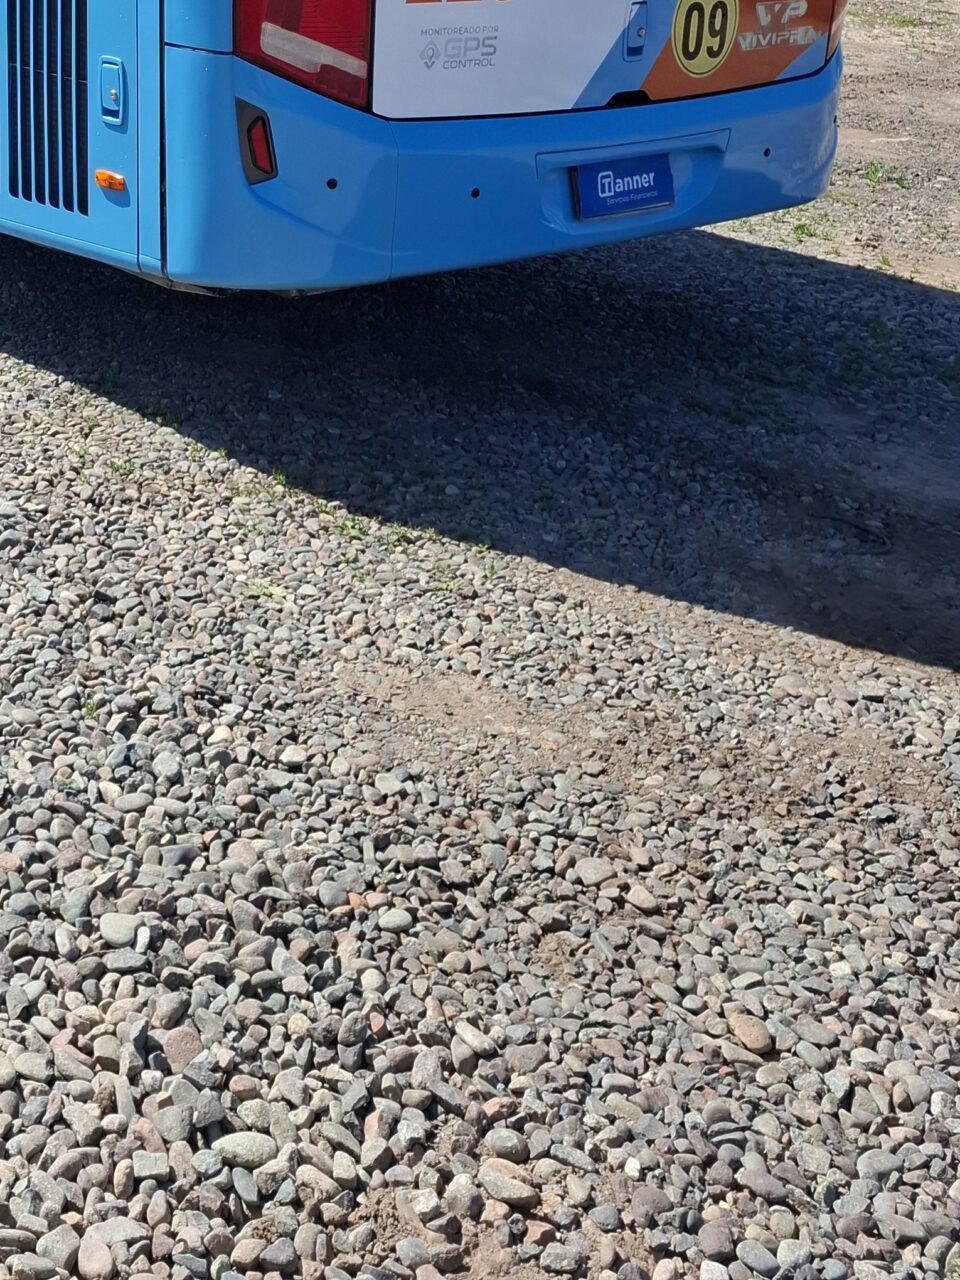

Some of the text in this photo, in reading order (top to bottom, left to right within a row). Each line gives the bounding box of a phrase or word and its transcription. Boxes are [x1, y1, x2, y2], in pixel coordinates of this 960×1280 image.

[420, 25, 499, 36] MONITOREADO POR
[681, 0, 729, 61] 09
[444, 36, 497, 59] GPS
[442, 58, 495, 70] CONTROL
[598, 171, 655, 197] Tanner
